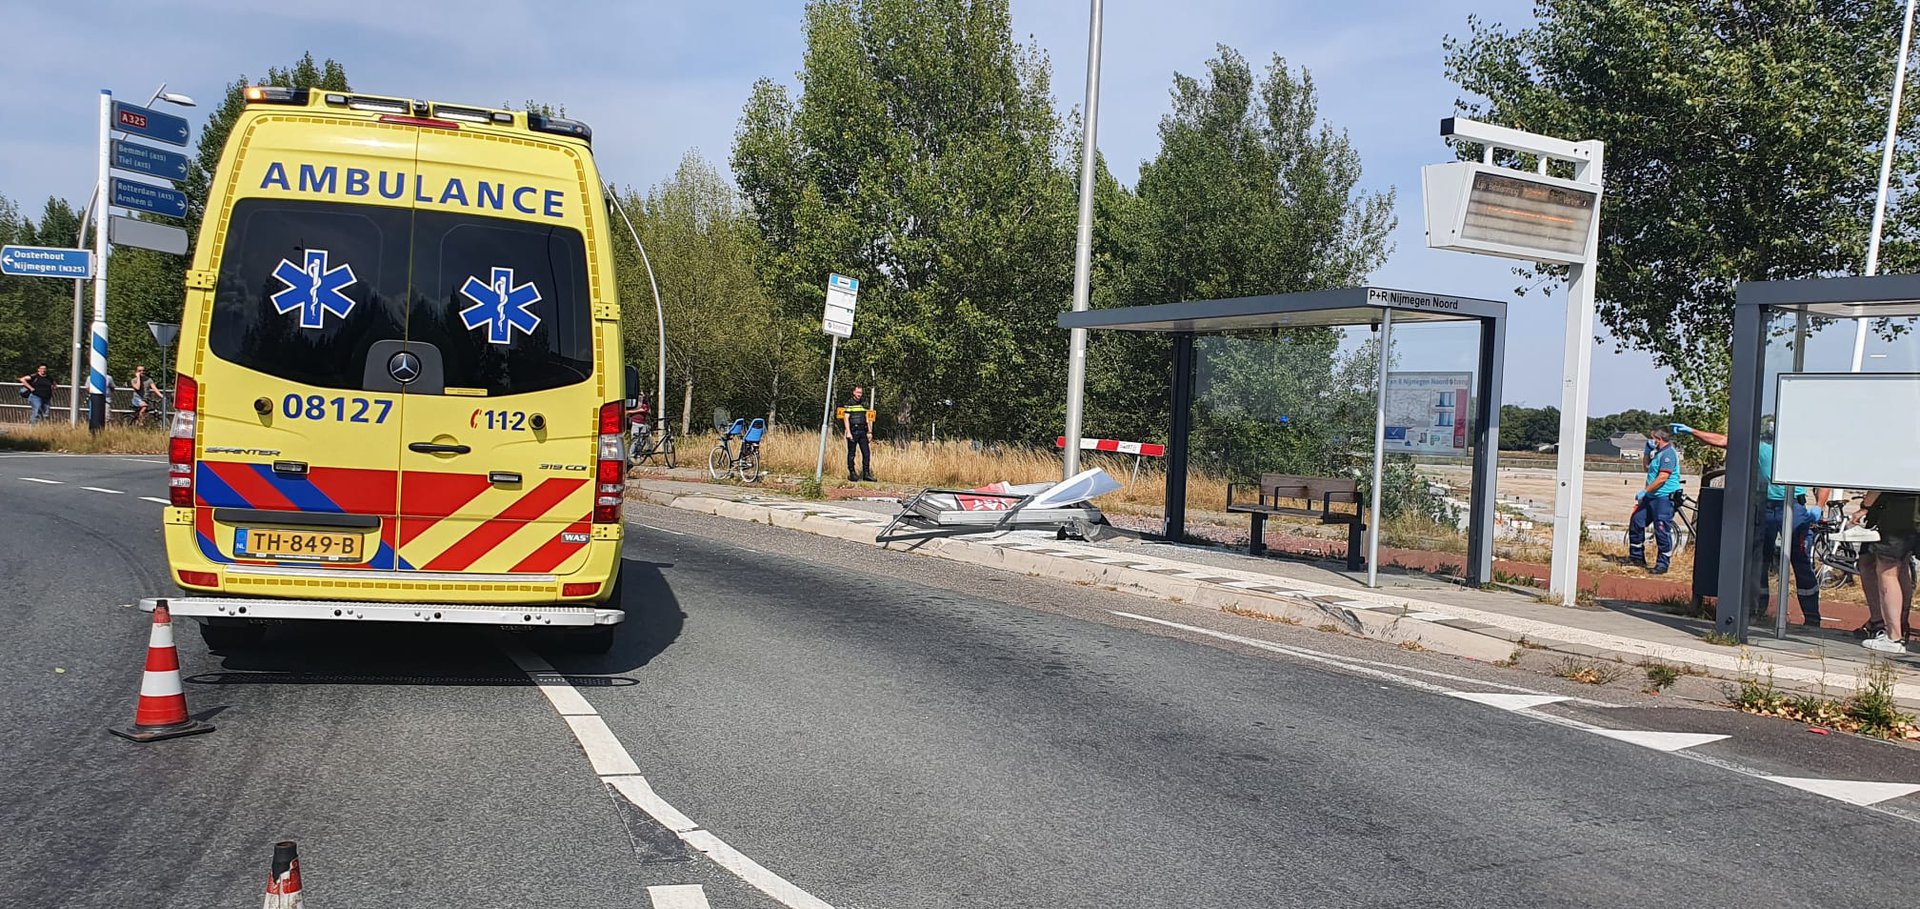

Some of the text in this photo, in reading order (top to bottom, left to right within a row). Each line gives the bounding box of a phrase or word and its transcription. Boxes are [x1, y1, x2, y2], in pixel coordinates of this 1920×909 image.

[122, 112, 146, 127] A325
[118, 144, 167, 161] Bemmel (A15)
[118, 156, 133, 166] Tiel
[118, 183, 175, 200] Rotterdam (A15)
[260, 162, 565, 218] AMBULANCE
[118, 194, 147, 206] Arnhem
[14, 250, 65, 260] Oosterhout
[14, 262, 86, 273] Nijmegen (N325)
[1369, 290, 1459, 310] P+R Nijmegen Noord
[282, 393, 393, 425] 08127
[484, 410, 526, 431] 1-1-2
[205, 446, 281, 456] SPRINTER
[539, 463, 563, 471] 319
[253, 533, 355, 554] TH-849-B
[564, 534, 587, 543] WAS
